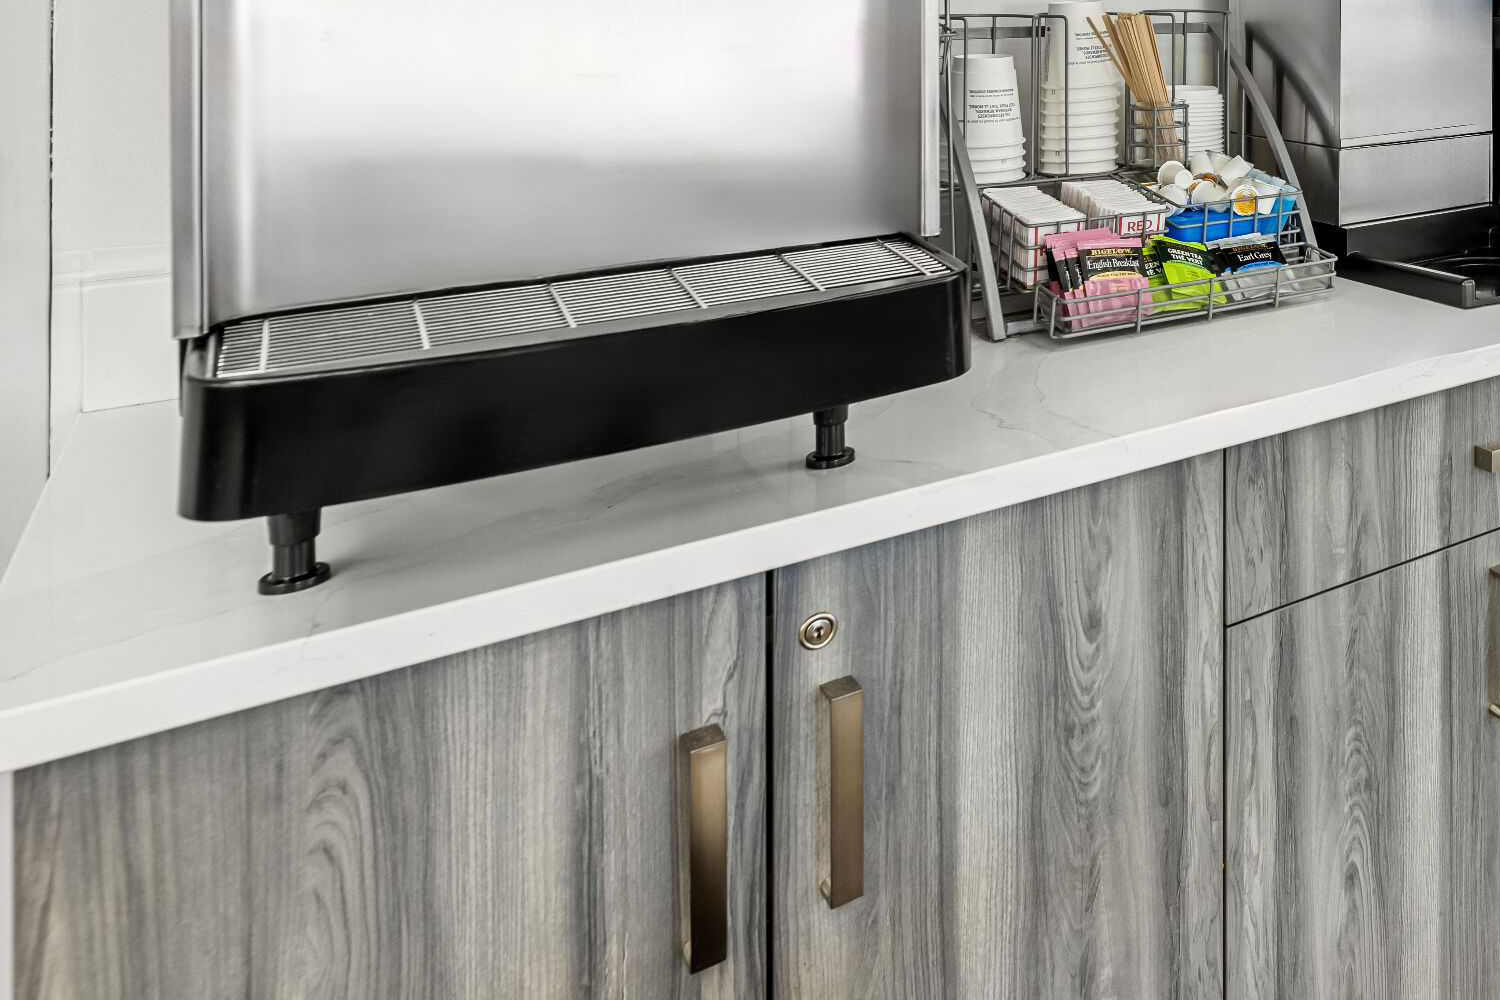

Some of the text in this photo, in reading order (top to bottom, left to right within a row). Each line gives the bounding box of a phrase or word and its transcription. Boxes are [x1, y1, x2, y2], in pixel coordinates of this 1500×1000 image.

[1167, 248, 1204, 261] GREEN TEA
[1236, 251, 1272, 262] Earl Grey
[1087, 259, 1112, 271] English
[1112, 256, 1140, 268] Breakfast
[1144, 260, 1160, 270] EEN
